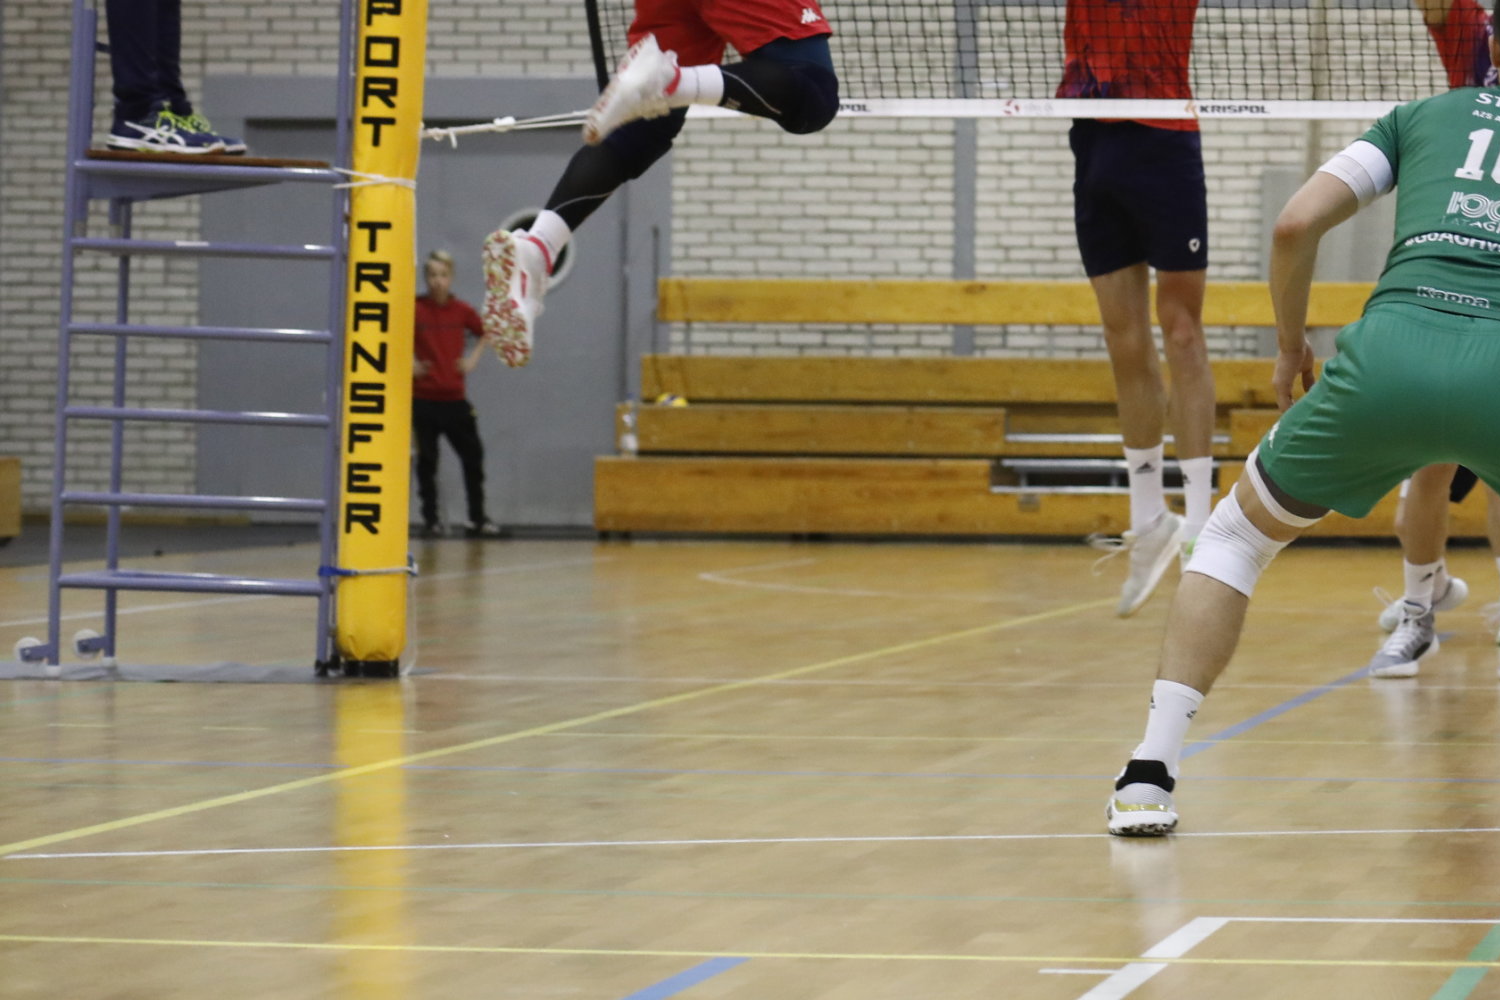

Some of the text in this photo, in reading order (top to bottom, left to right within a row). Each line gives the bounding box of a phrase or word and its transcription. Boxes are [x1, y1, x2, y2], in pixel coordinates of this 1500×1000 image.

[1199, 105, 1270, 114] KRISPOL
[1472, 109, 1494, 120] AZS
[1416, 285, 1490, 309] Kappa
[345, 221, 392, 535] TRANSFER
